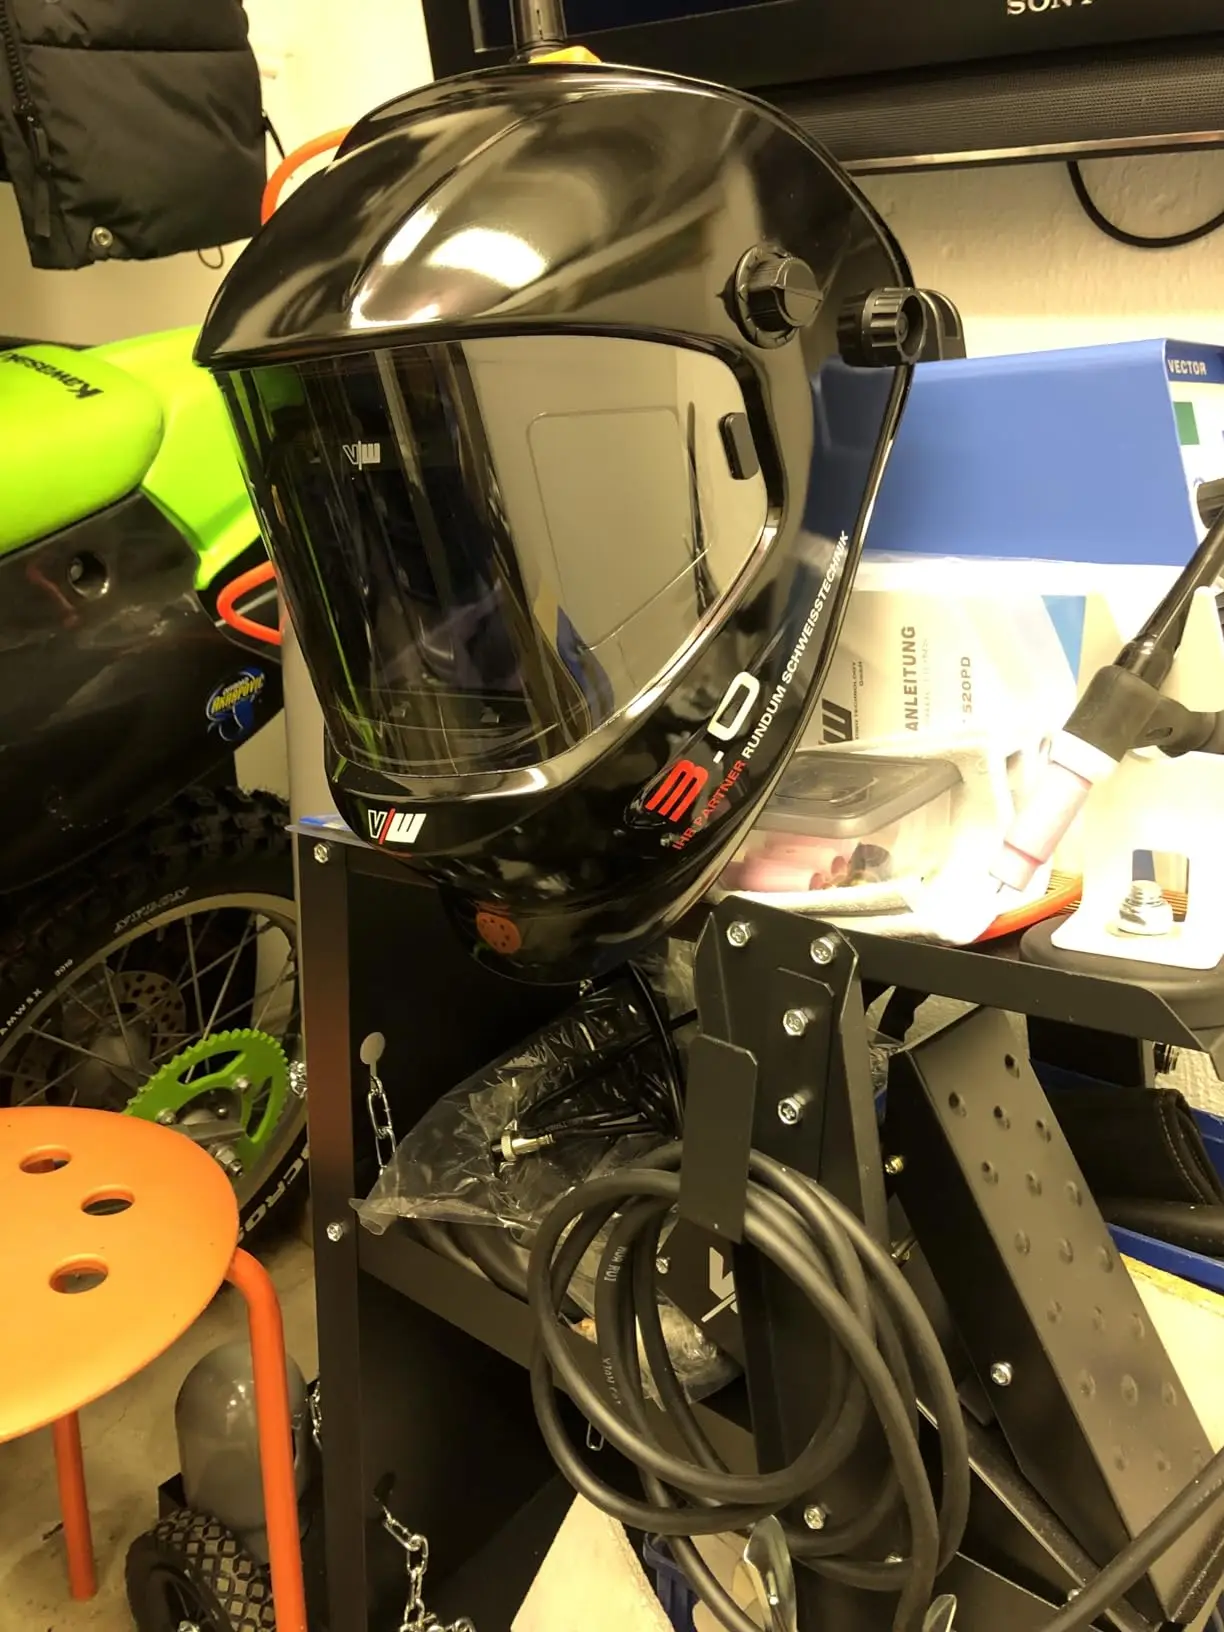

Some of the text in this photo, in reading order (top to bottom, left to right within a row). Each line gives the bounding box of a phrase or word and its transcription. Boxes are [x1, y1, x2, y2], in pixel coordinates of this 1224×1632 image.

[1167, 359, 1207, 375] VECTOR
[693, 759, 748, 827] PARTNER
[742, 684, 787, 759] RUNDUM
[781, 530, 848, 684] SCHWEISSTECHNIK
